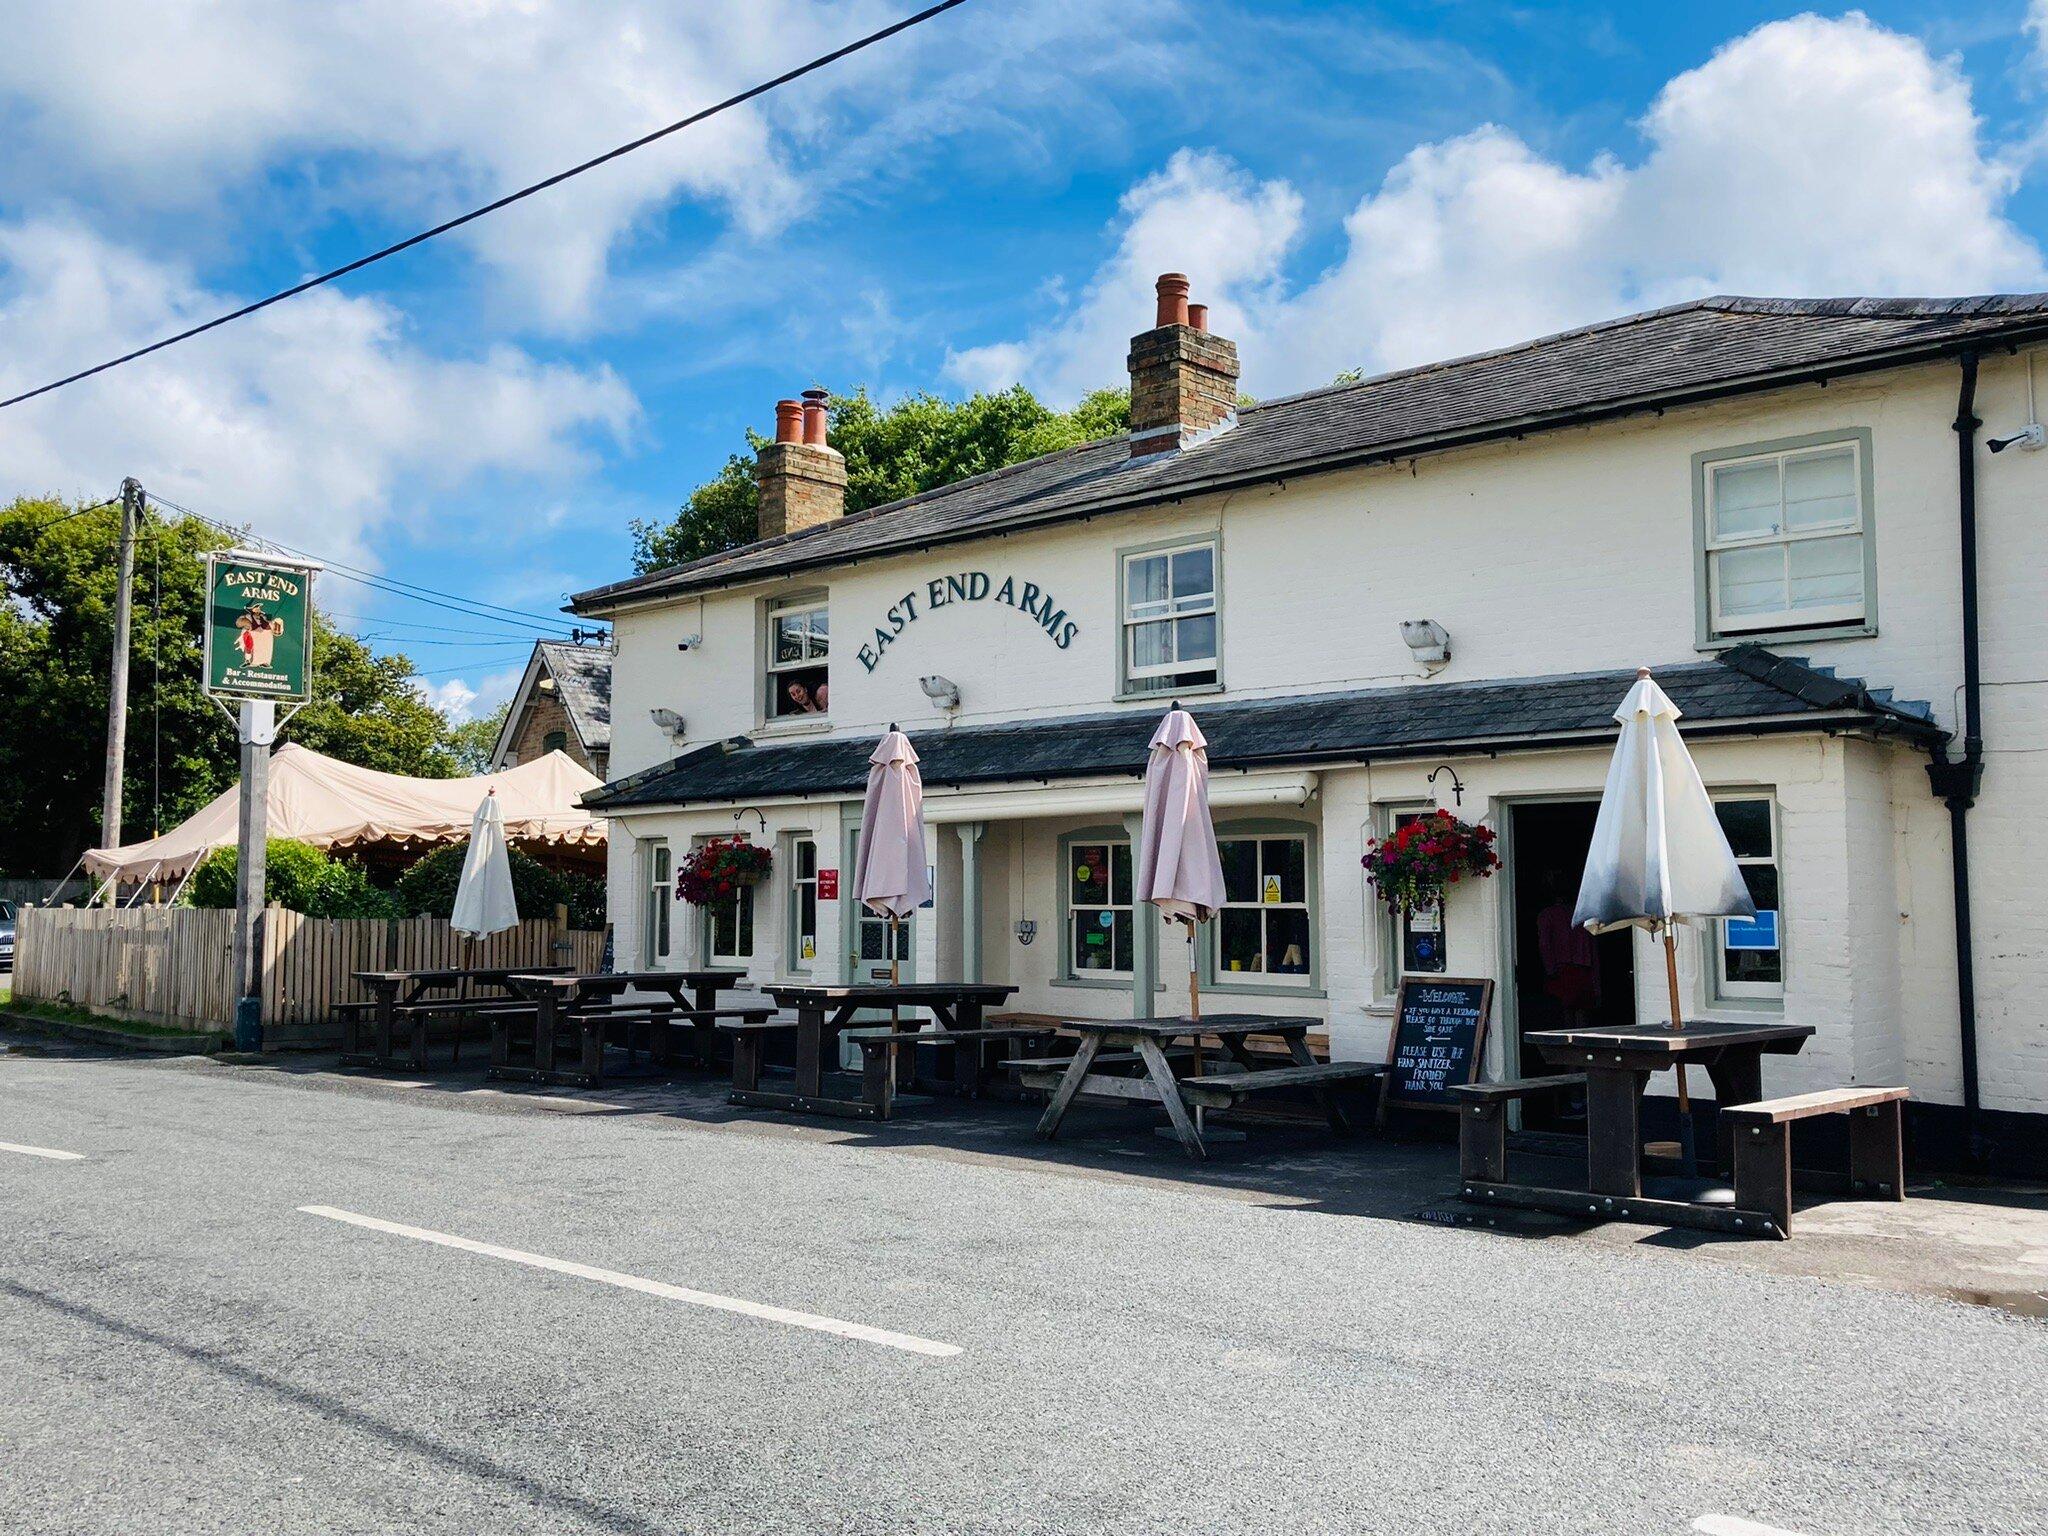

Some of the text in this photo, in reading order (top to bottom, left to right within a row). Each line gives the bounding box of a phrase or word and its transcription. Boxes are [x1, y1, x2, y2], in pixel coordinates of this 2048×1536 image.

[225, 571, 299, 596] EAST END
[242, 586, 280, 601] ARMS
[856, 571, 1079, 674] EAST END ARMS
[226, 667, 241, 677] Bar
[247, 669, 288, 682] Restaurant
[222, 676, 292, 691] & Accommodation
[1405, 1014, 1425, 1024] PLEASE
[1402, 1046, 1465, 1060] PLEASE USE THE
[1397, 1058, 1455, 1070] HAND SANITIZER
[1404, 1080, 1444, 1092] THANK YOU
